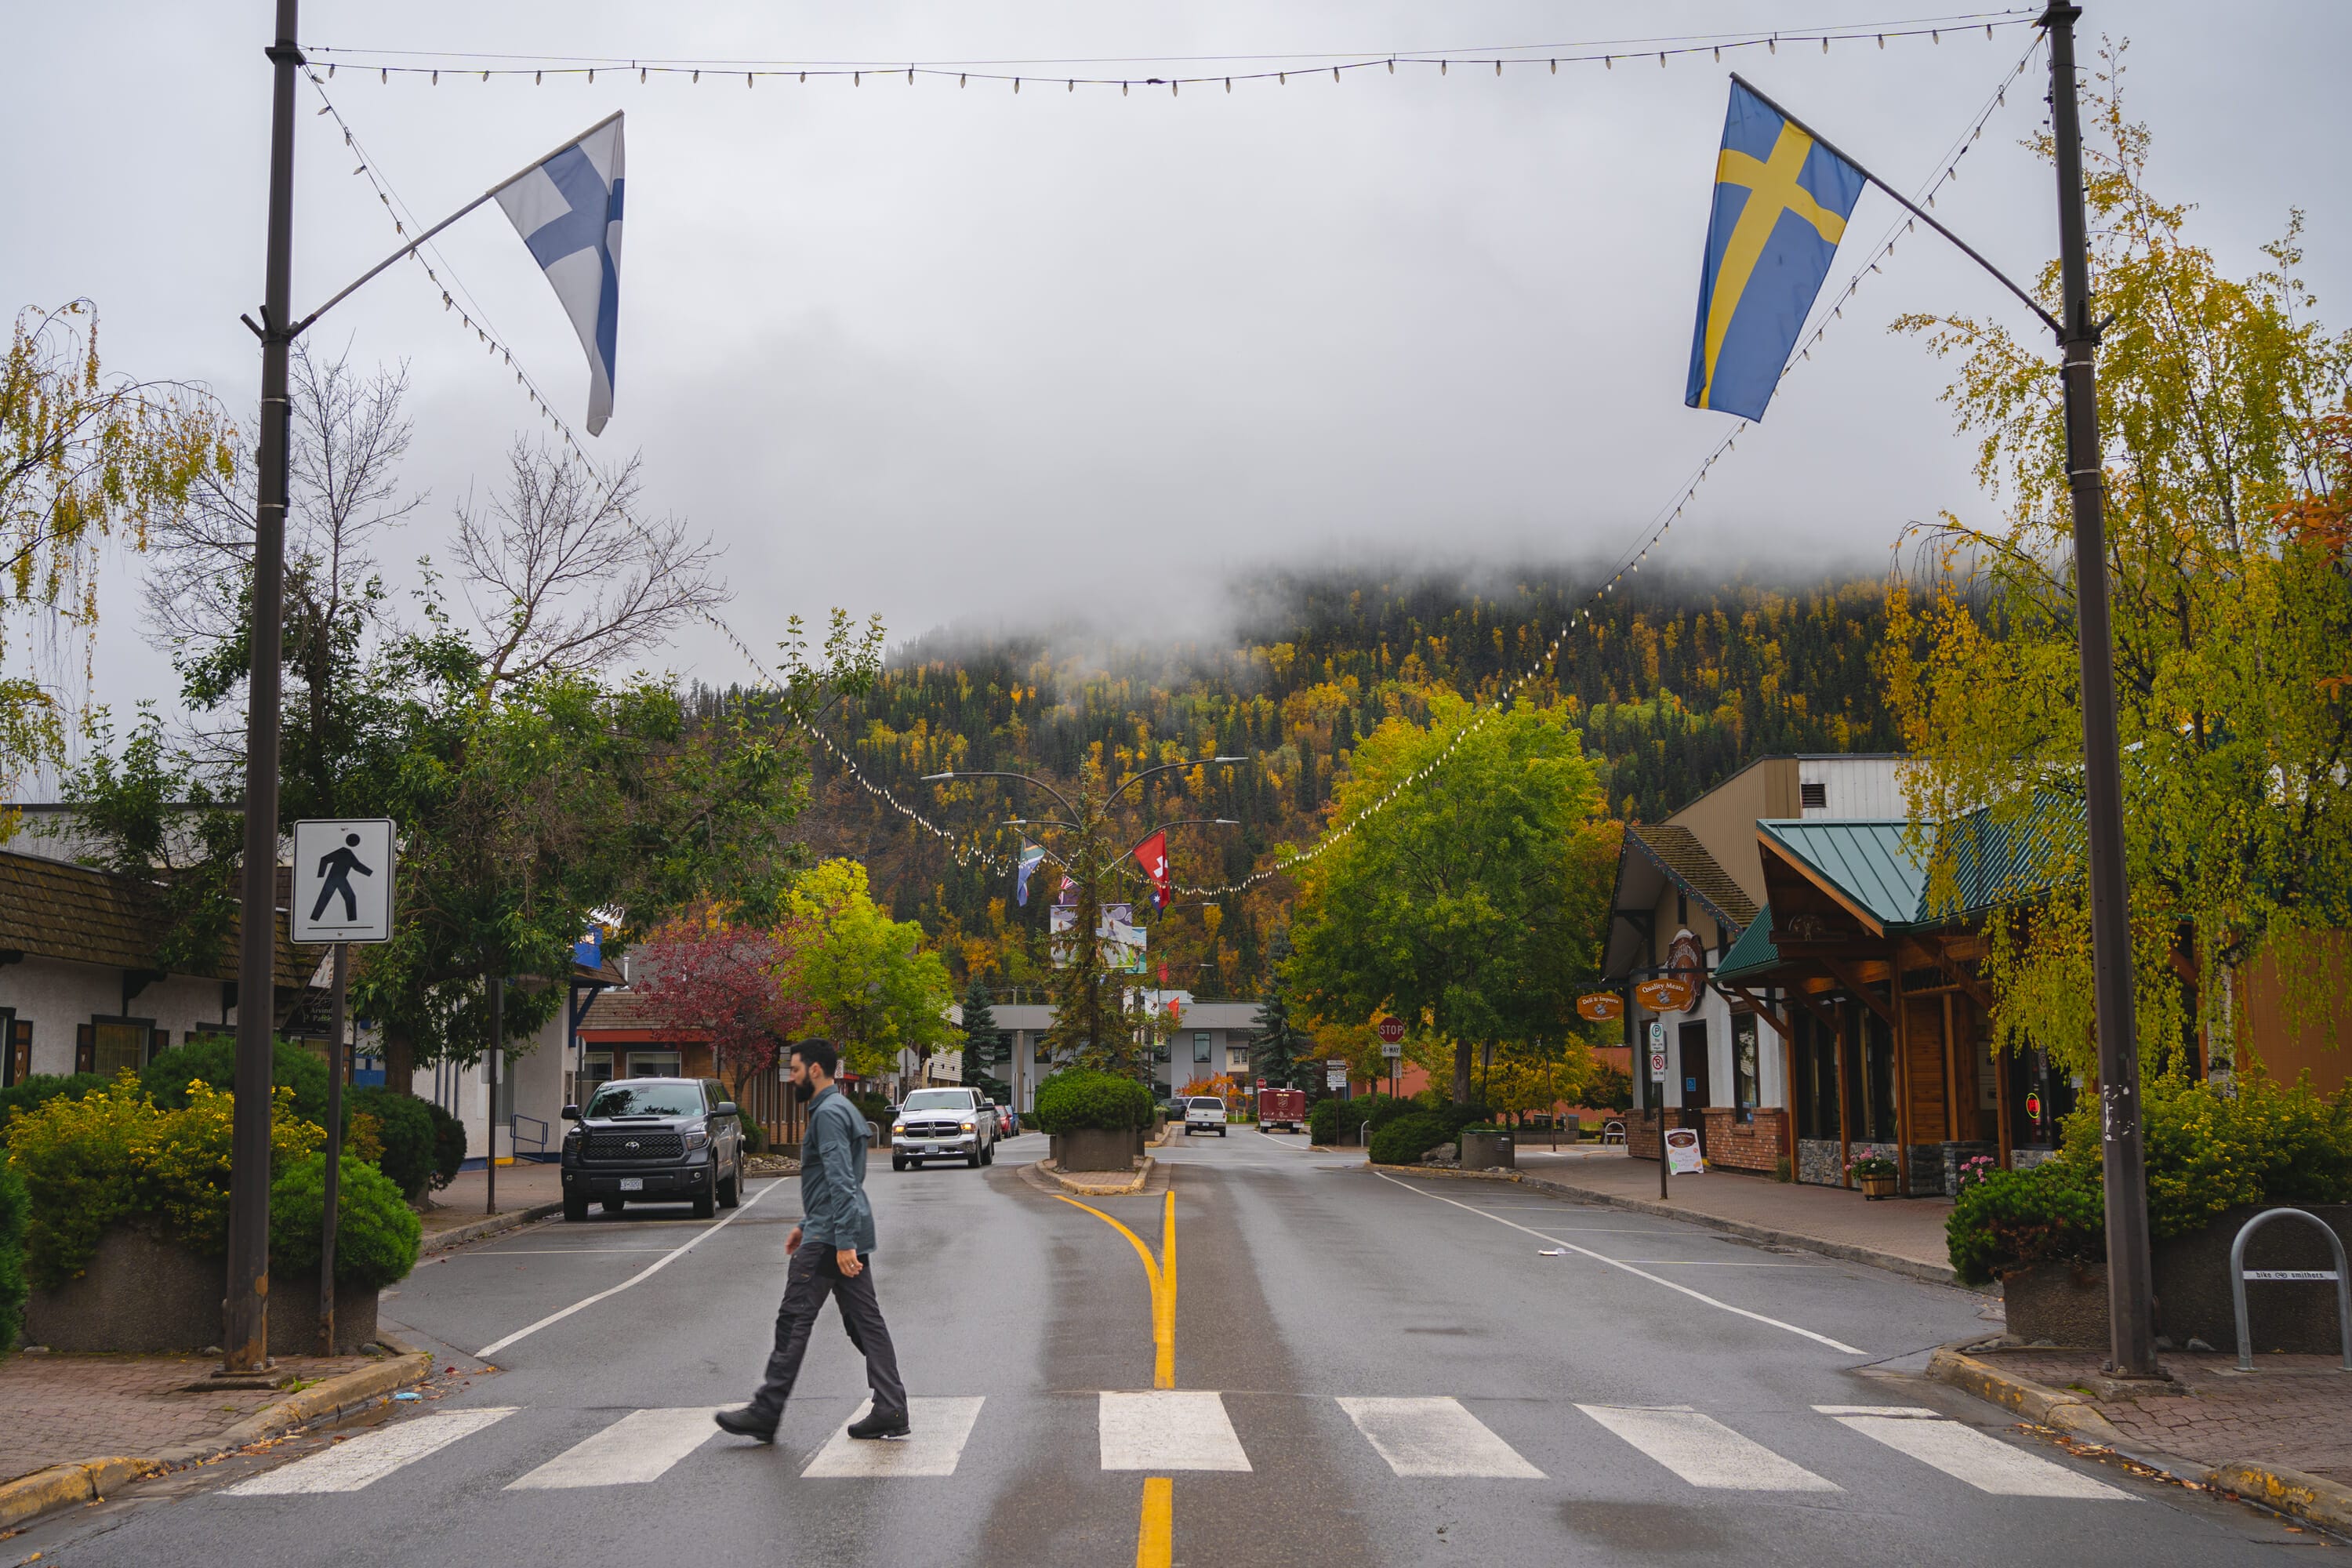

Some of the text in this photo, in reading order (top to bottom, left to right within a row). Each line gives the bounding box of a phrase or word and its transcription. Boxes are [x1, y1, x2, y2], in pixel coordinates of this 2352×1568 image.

[1642, 982, 1684, 993] Quality Meats
[1380, 1025, 1403, 1035] STOP
